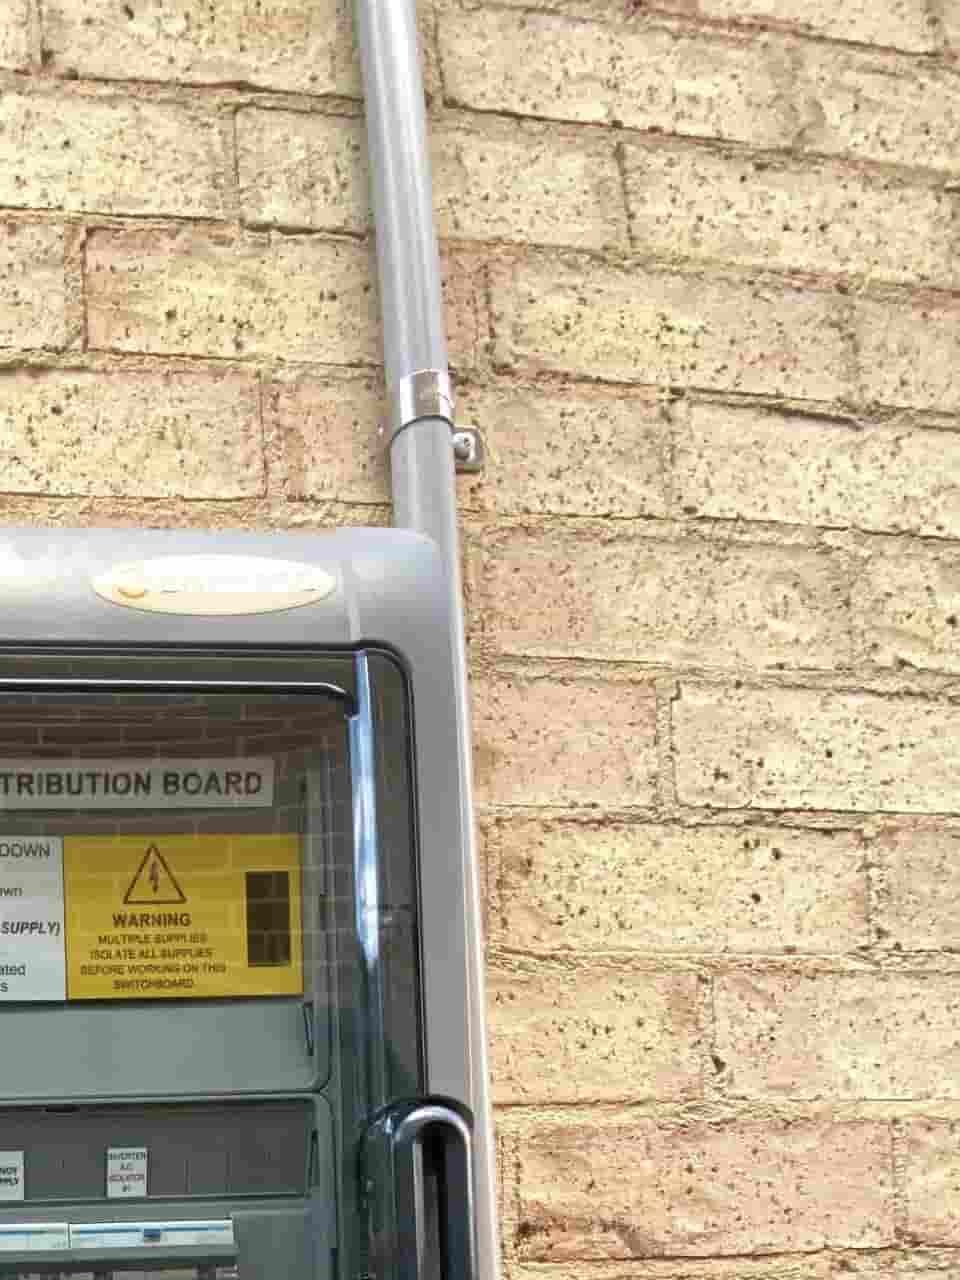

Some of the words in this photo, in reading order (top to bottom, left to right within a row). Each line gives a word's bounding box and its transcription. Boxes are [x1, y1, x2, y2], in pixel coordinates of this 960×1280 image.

[163, 771, 262, 796] BOARD
[112, 912, 192, 928] WARNING
[1, 921, 61, 937] SUPPLY)
[98, 934, 150, 945] MULTIPLE
[90, 949, 136, 960] ISOLATE
[139, 949, 157, 960] ALL
[80, 964, 124, 976] BEFORE
[127, 963, 181, 975] WORKING
[183, 963, 200, 975] ON
